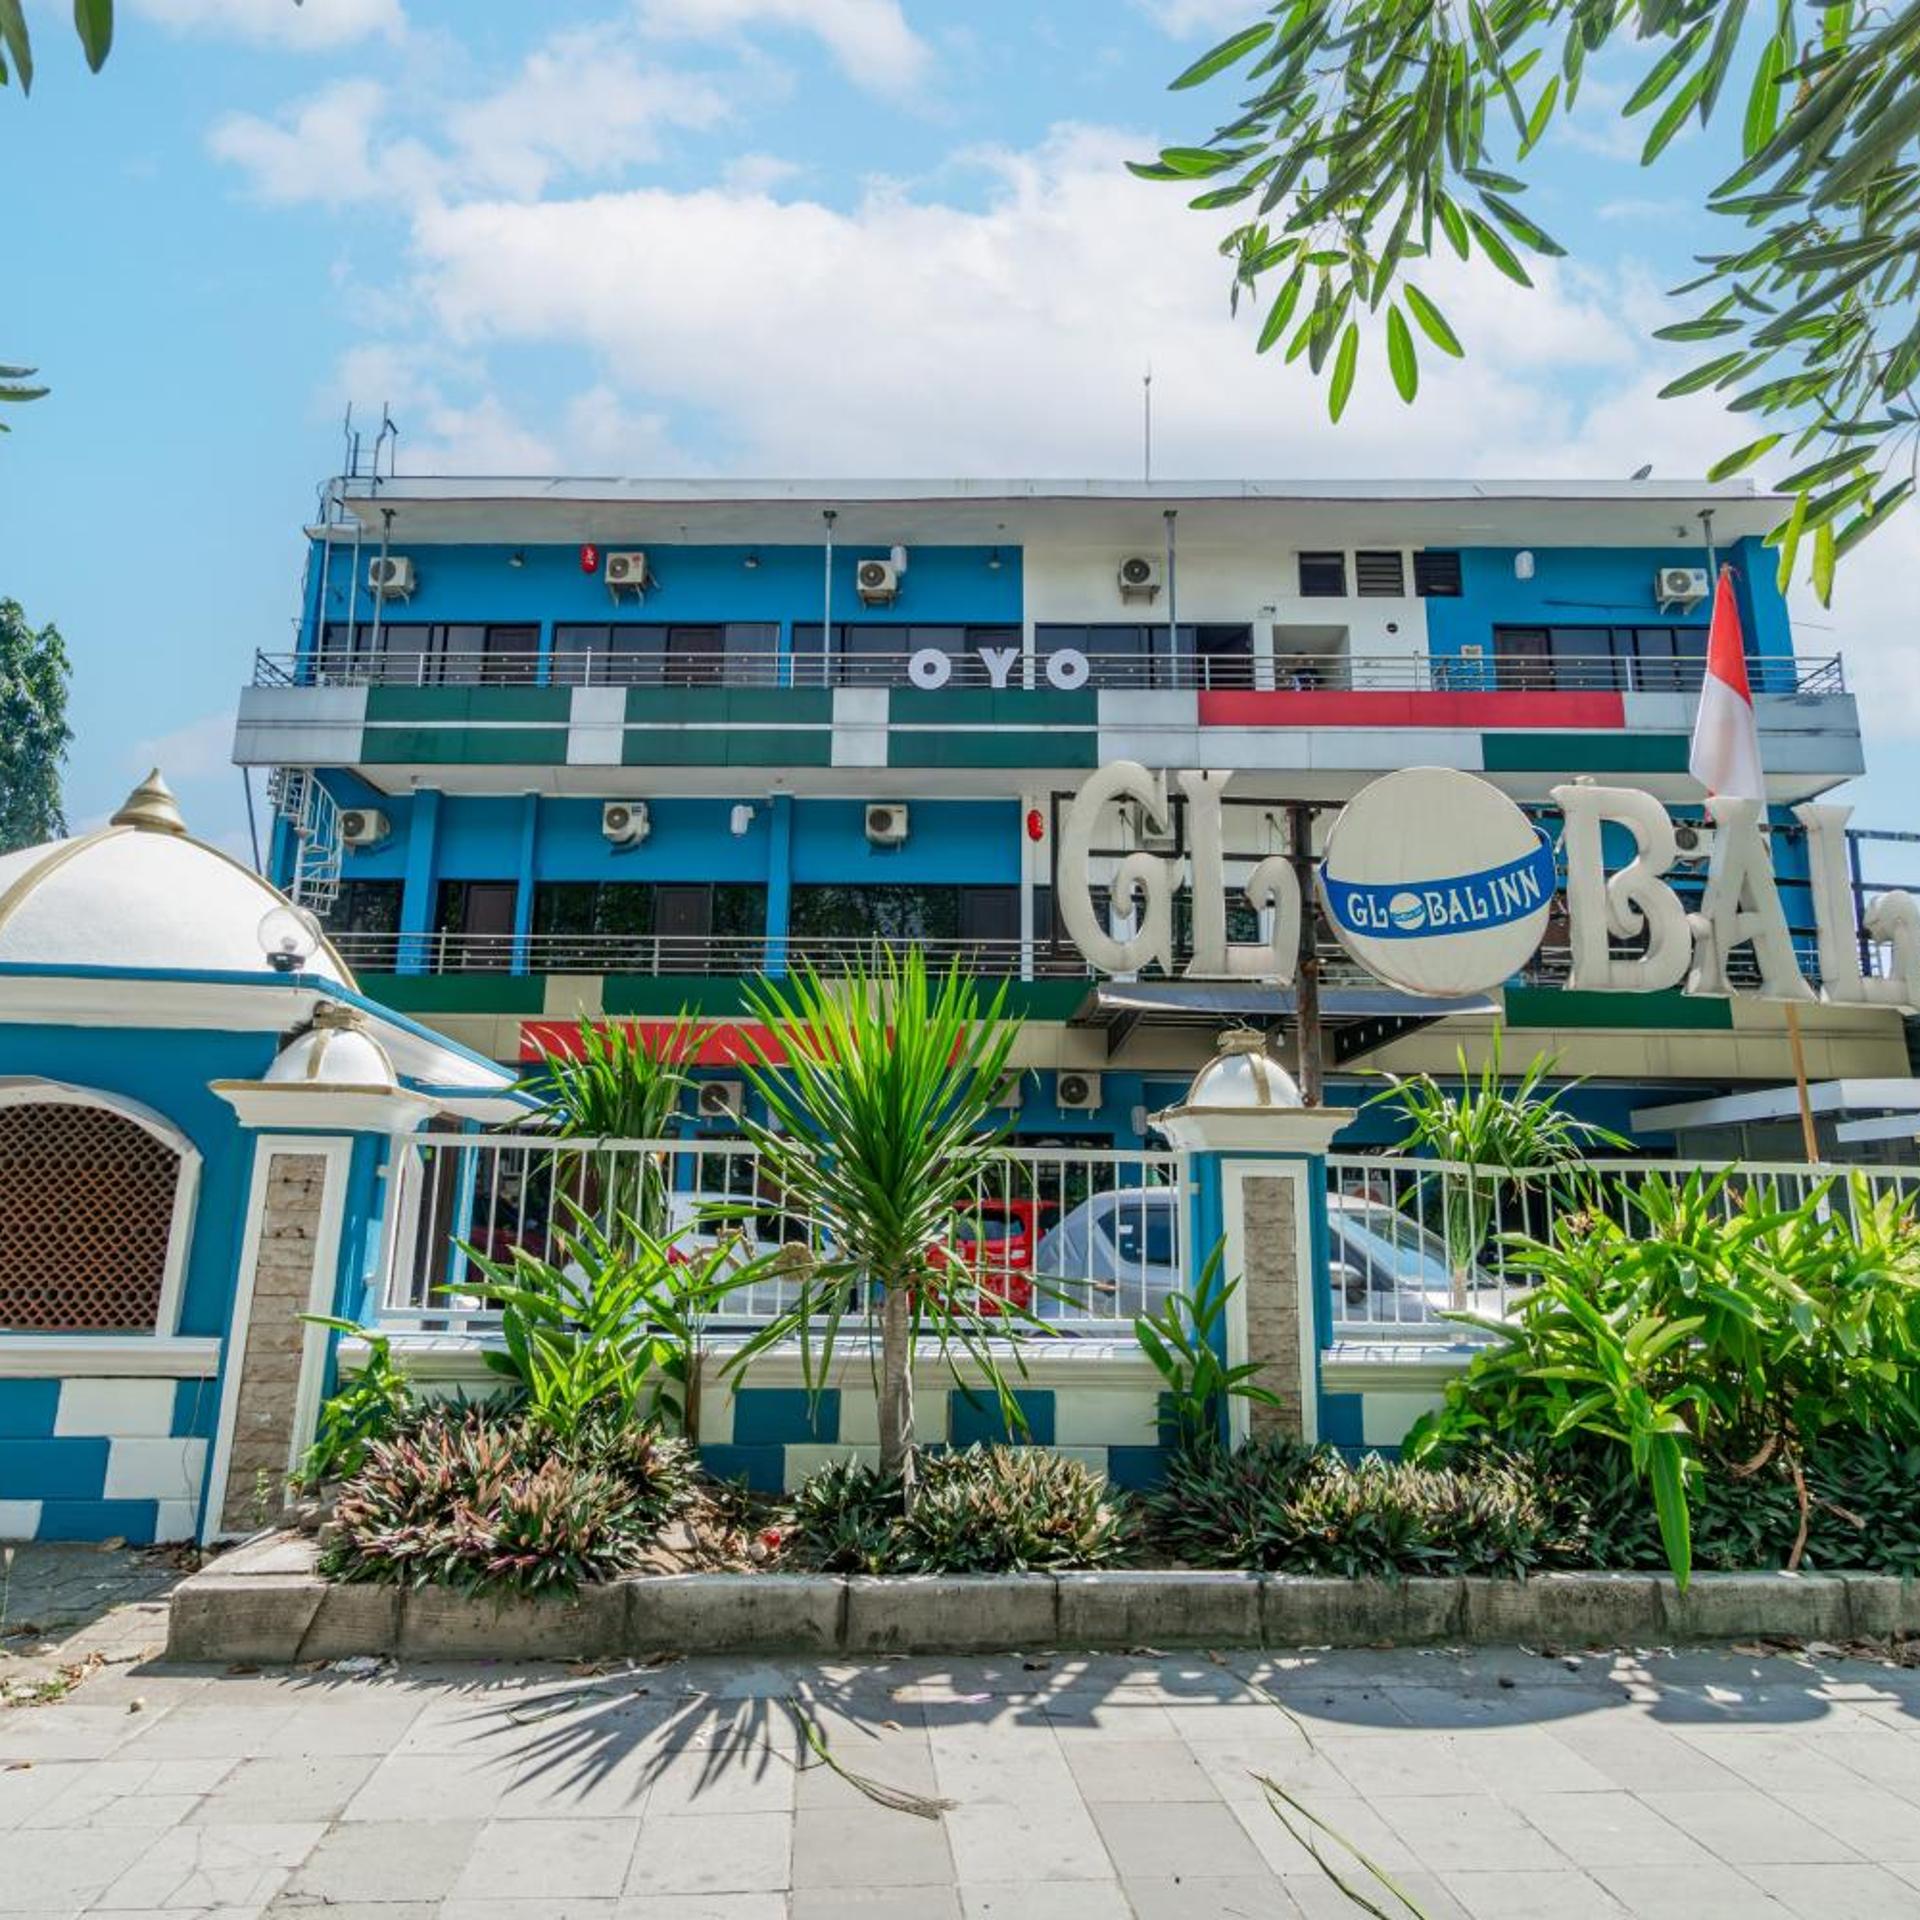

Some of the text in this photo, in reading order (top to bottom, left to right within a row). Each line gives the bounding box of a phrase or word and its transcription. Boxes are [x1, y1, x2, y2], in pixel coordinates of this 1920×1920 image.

[908, 647, 1090, 690] OYO
[1347, 865, 1541, 930] GLOBAL INN
